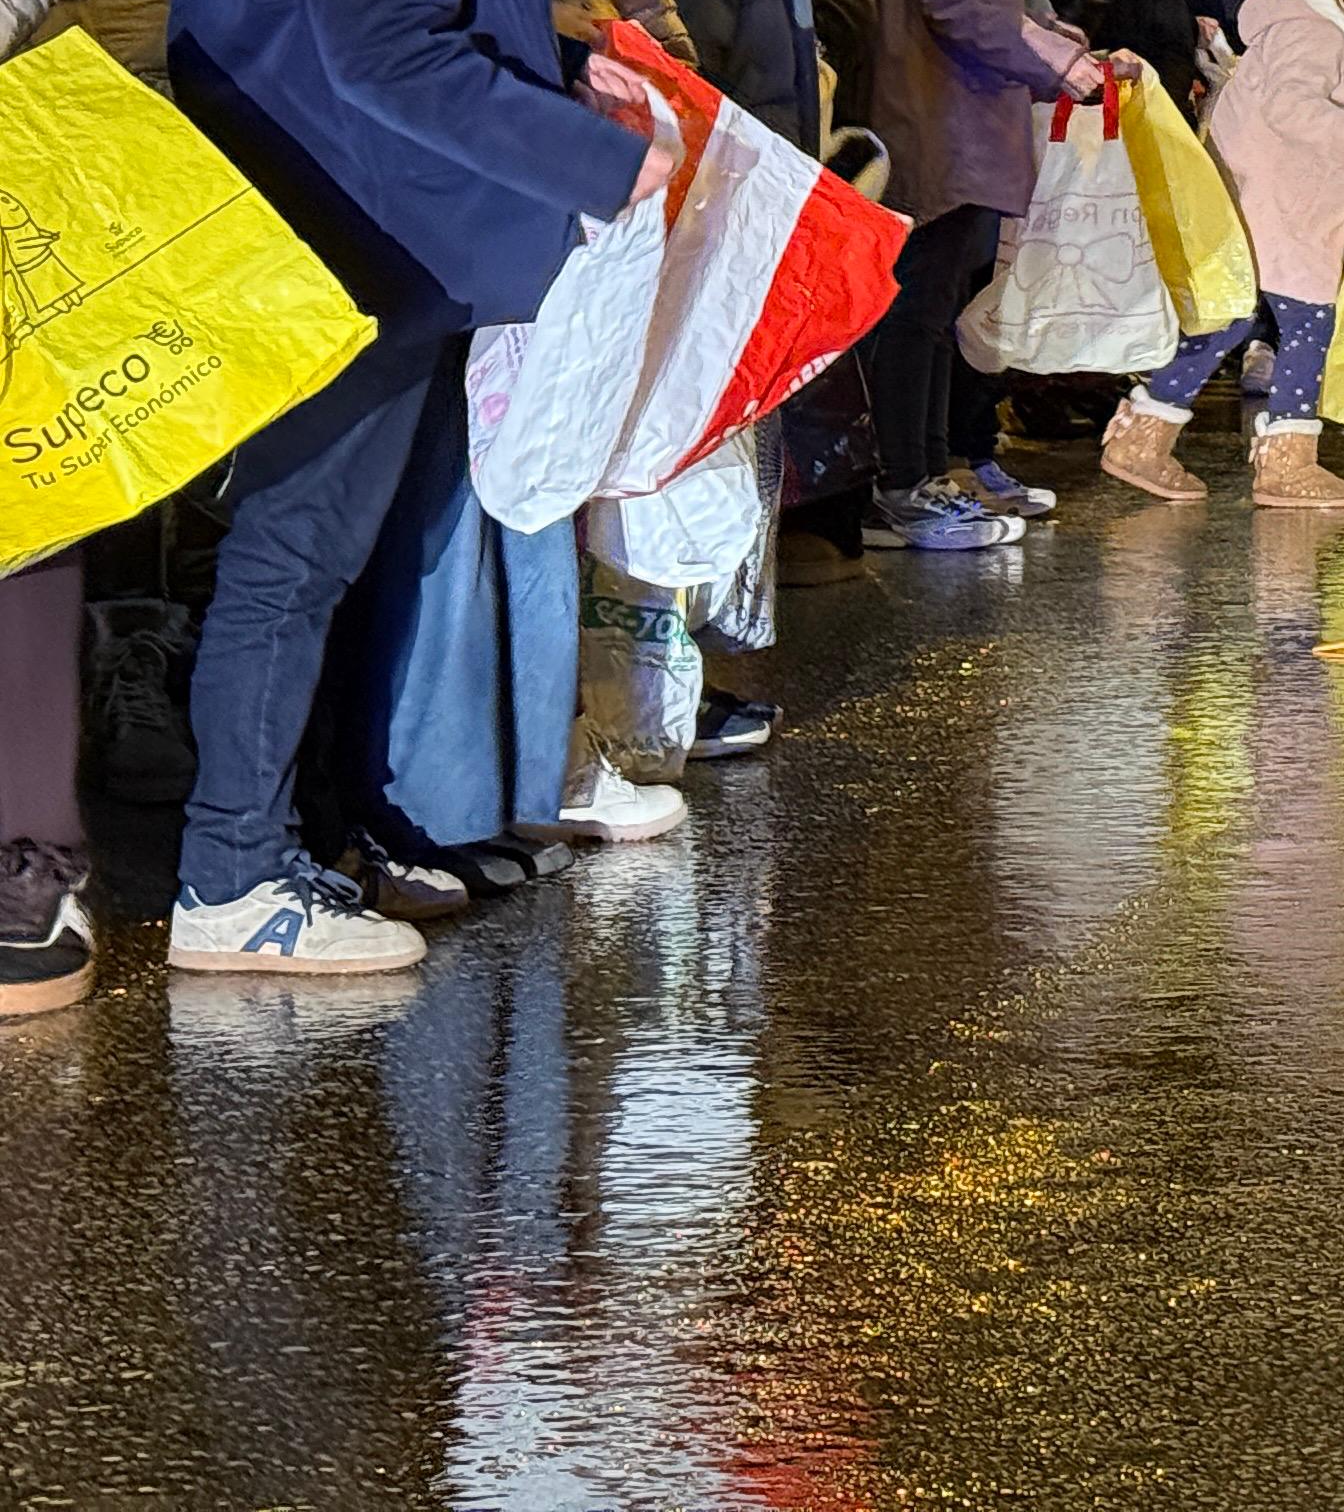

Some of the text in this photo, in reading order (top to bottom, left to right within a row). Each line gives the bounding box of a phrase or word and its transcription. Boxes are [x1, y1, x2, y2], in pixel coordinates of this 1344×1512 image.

[4, 353, 151, 464] Supeco
[21, 354, 223, 490] Tu Super Económico
